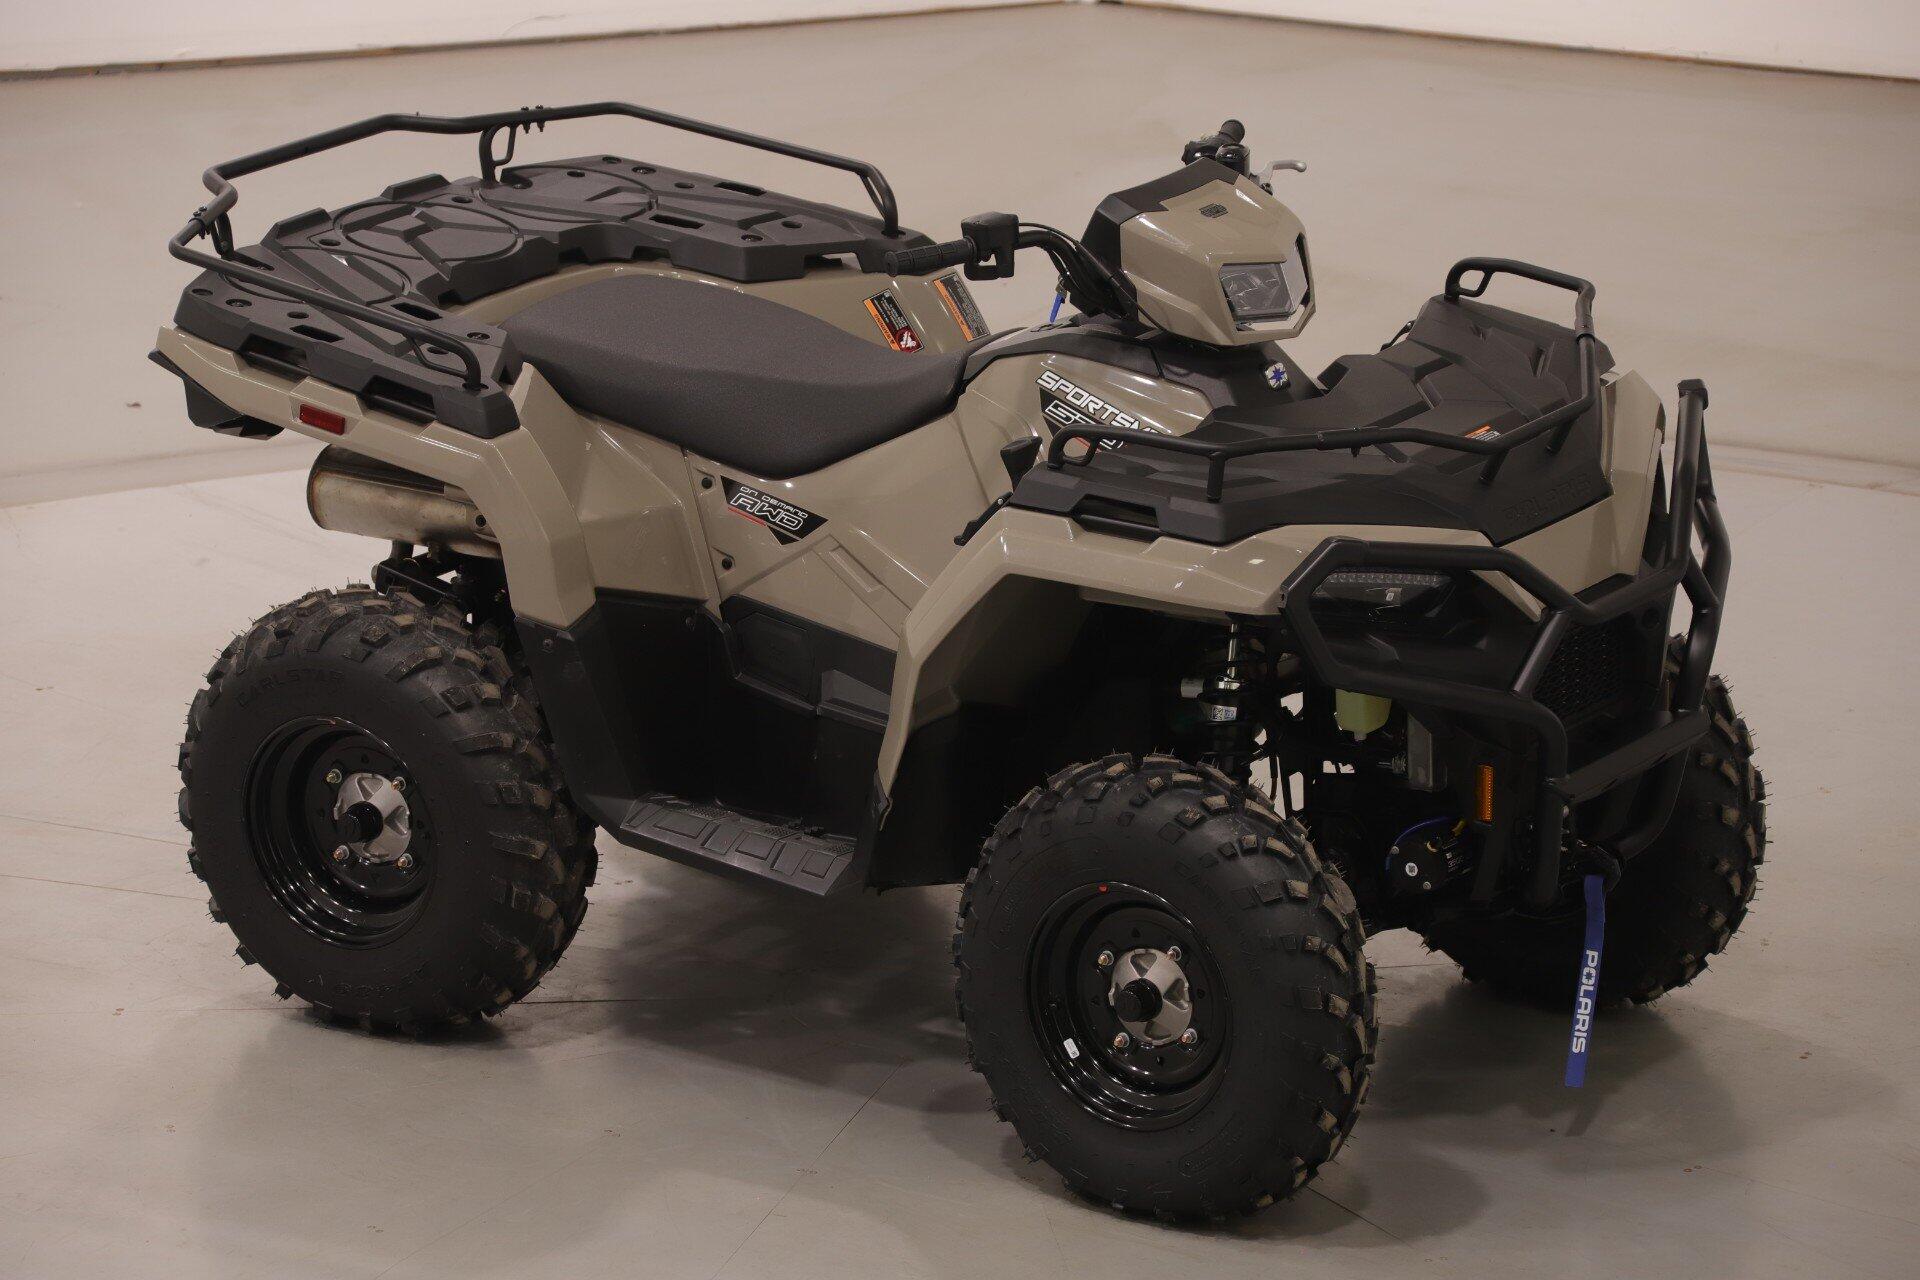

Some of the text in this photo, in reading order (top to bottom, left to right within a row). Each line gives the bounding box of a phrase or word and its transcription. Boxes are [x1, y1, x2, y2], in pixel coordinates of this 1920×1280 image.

[1036, 370, 1158, 434] SPORTS
[730, 493, 803, 530] AWD
[1572, 949, 1599, 1053] POLARIS
